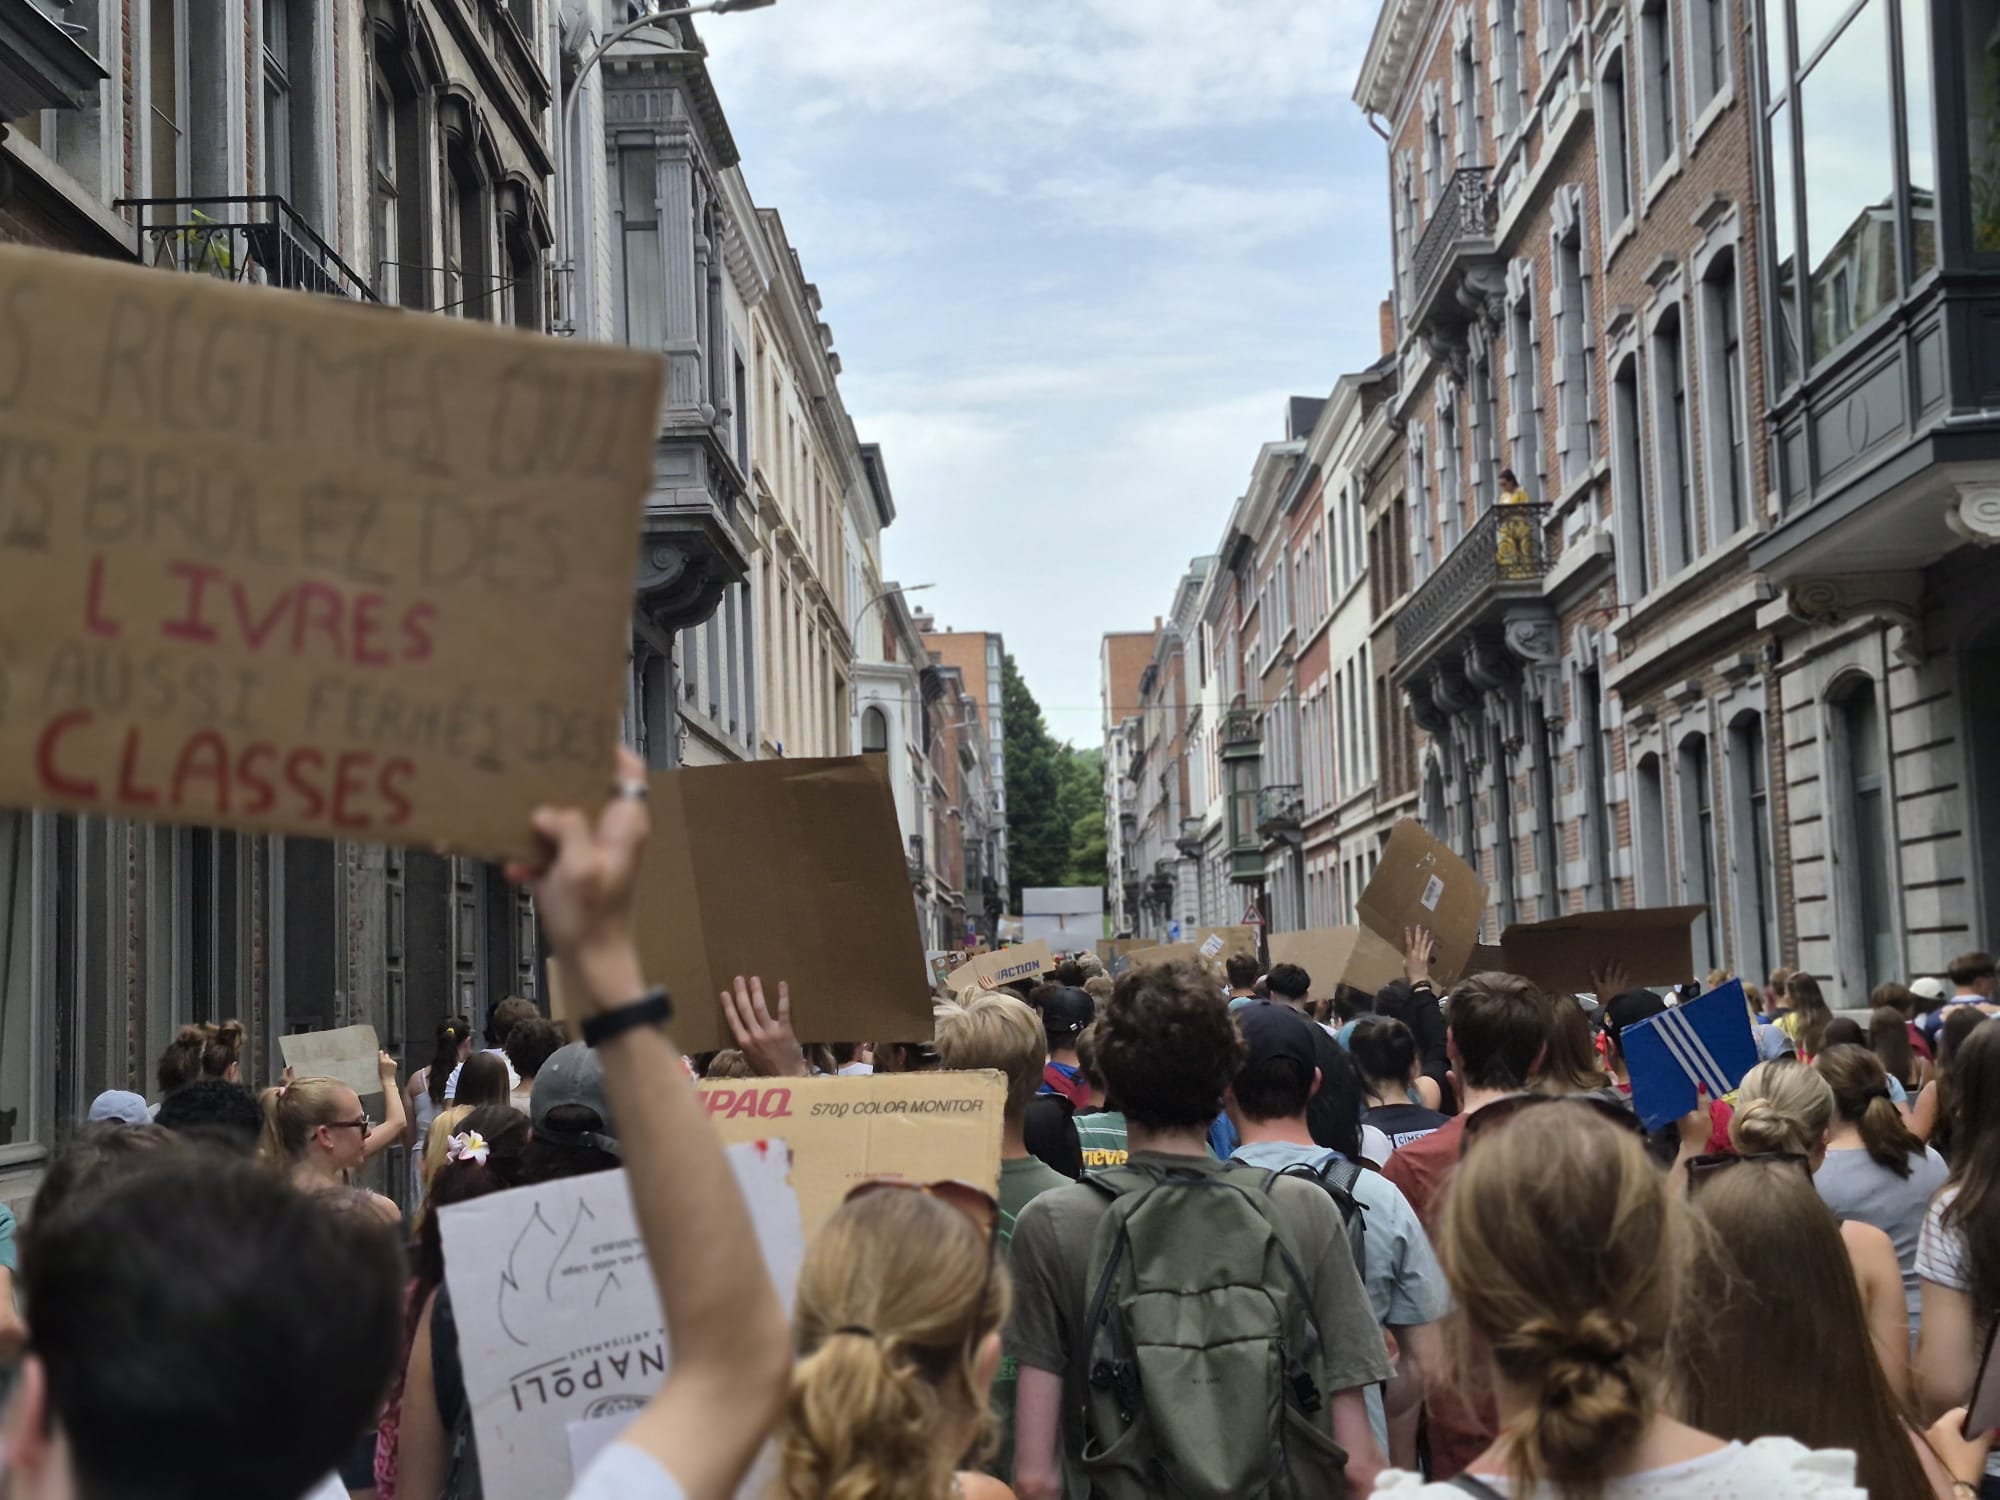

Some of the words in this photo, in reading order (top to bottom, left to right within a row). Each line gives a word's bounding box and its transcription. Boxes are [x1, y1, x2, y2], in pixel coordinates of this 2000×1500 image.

[420, 491, 571, 592] DES
[86, 556, 438, 667] LIVRES
[41, 635, 263, 730] AUSSI
[36, 711, 416, 828] CLASSES
[999, 960, 1040, 979] ACTION
[853, 1101, 907, 1114] COLOR
[910, 1099, 984, 1113] MONITOR
[511, 1344, 665, 1412] NAPOLI
